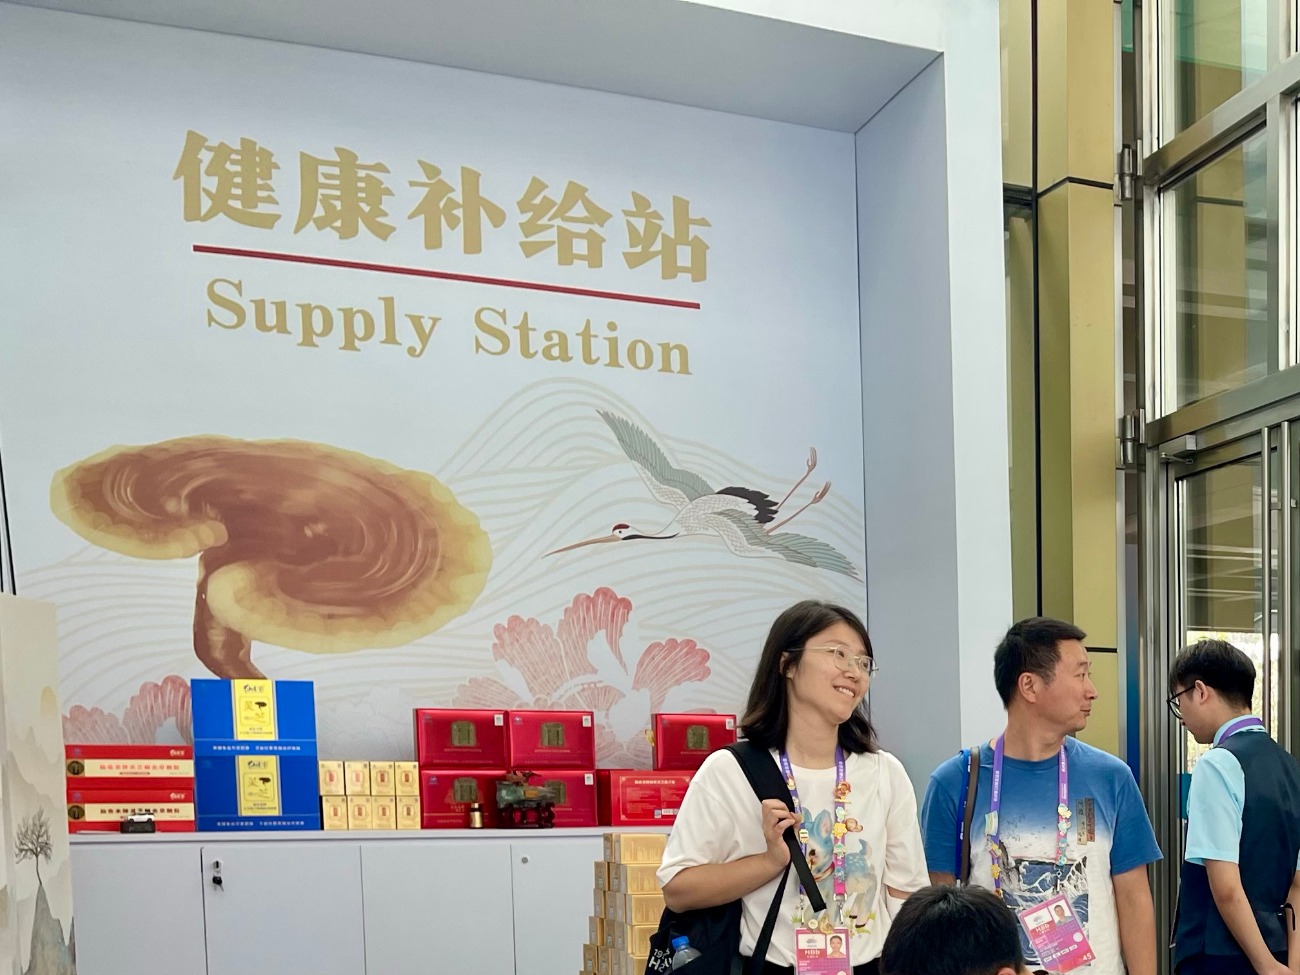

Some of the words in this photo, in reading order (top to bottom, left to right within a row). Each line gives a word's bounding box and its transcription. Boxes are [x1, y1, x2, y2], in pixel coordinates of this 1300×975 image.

[173, 129, 712, 282] 健康补给站
[206, 278, 442, 358] Supply
[474, 307, 693, 375] Station
